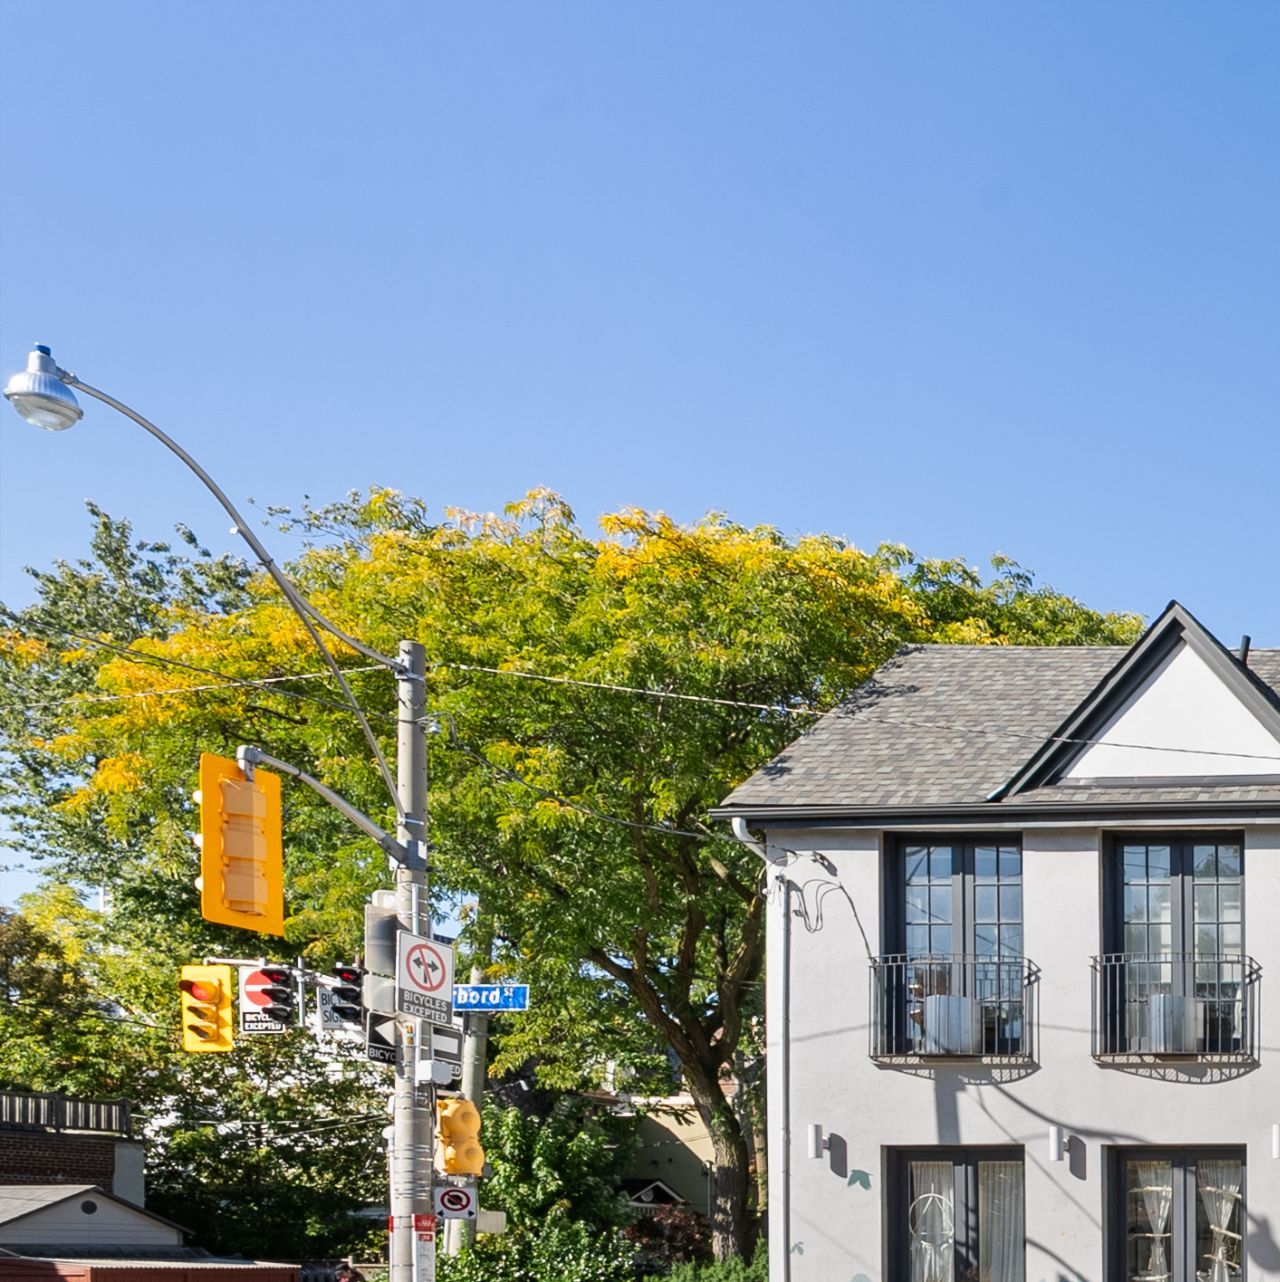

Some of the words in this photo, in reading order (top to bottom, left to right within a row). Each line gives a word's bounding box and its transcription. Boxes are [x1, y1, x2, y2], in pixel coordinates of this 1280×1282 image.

[404, 991, 447, 1011] BICYCLES
[453, 988, 500, 1004] bord
[403, 1003, 447, 1022] EXCEPTED
